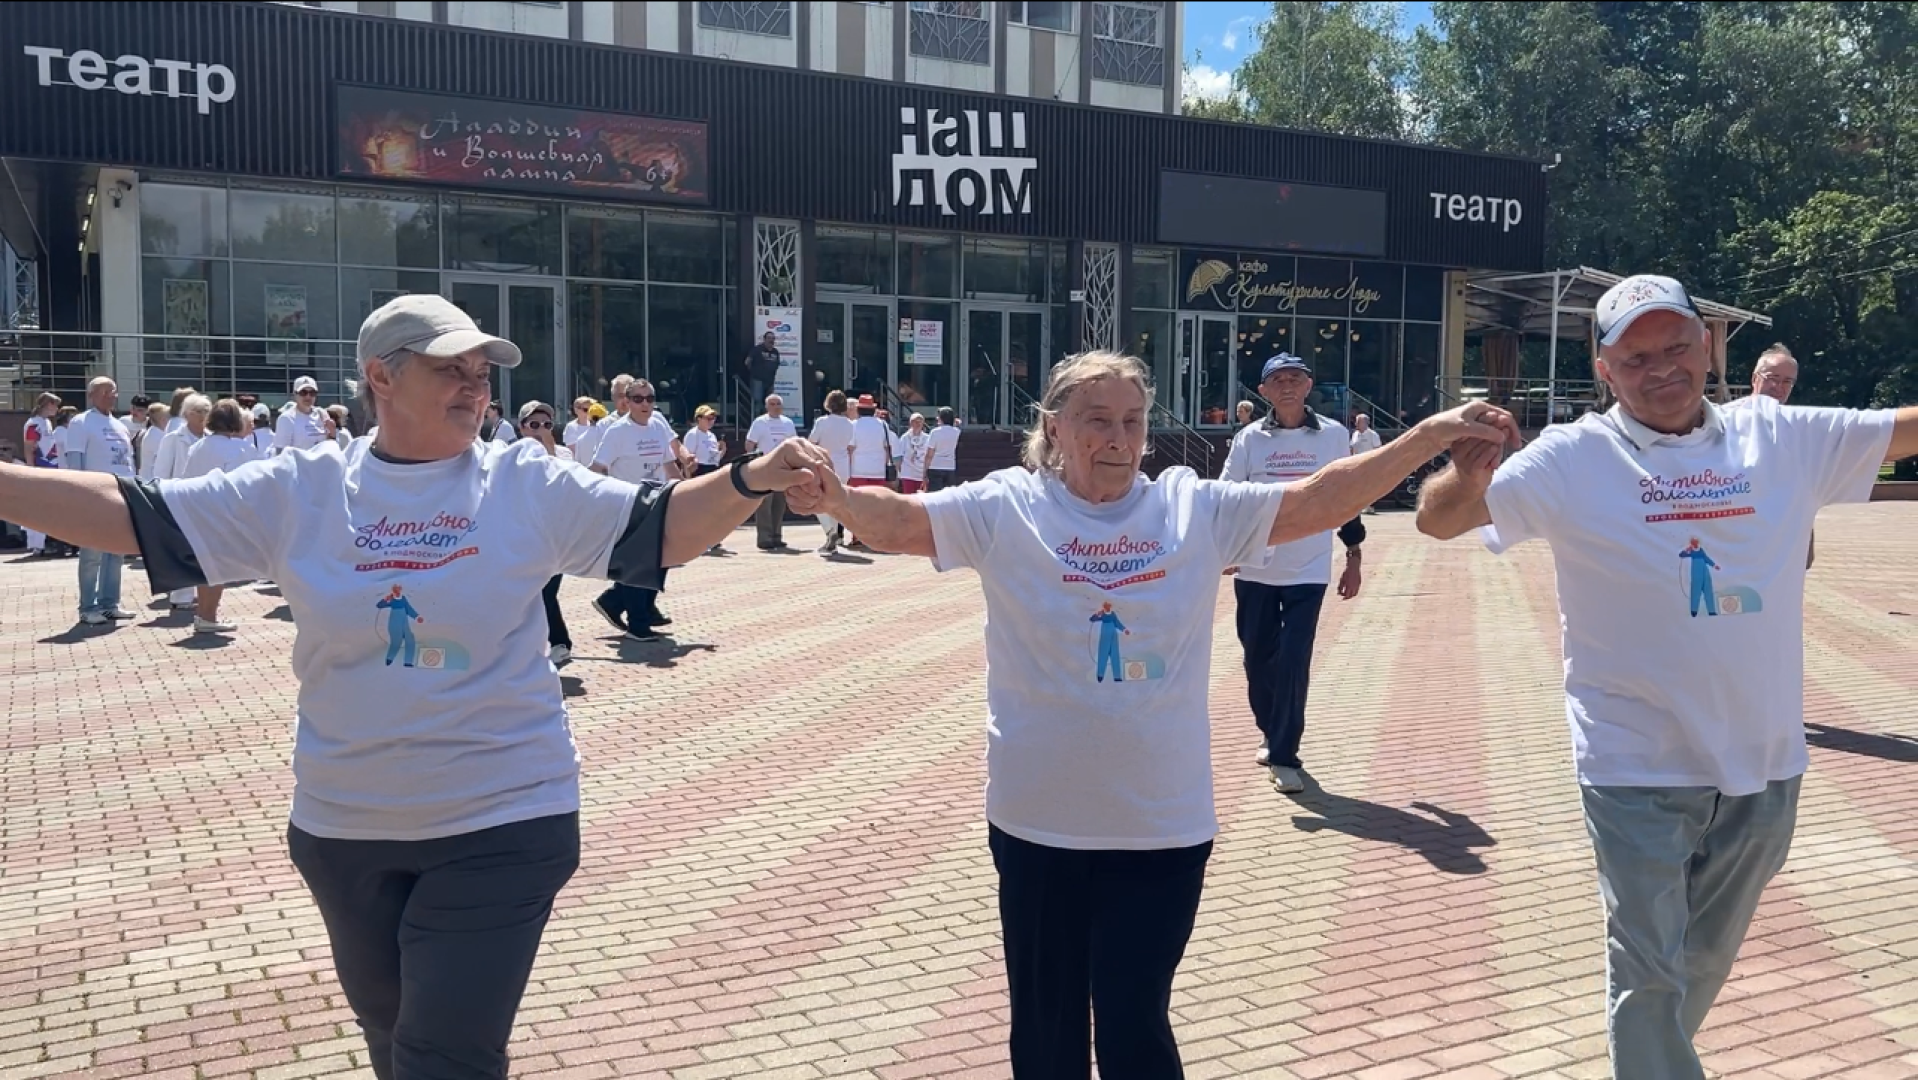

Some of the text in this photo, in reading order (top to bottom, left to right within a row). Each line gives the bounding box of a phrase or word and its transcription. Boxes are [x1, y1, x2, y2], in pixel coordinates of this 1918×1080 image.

[24, 45, 236, 115] театр
[420, 109, 582, 140] Аладдин
[433, 135, 603, 173] и Волшебная
[482, 166, 576, 182] лампа
[646, 166, 668, 182] 6+
[1430, 192, 1522, 233] театр
[1239, 259, 1269, 274] кафе
[1226, 273, 1381, 313] Культурные Люди
[1641, 480, 1752, 504] долголетие
[1056, 535, 1160, 556] Активное
